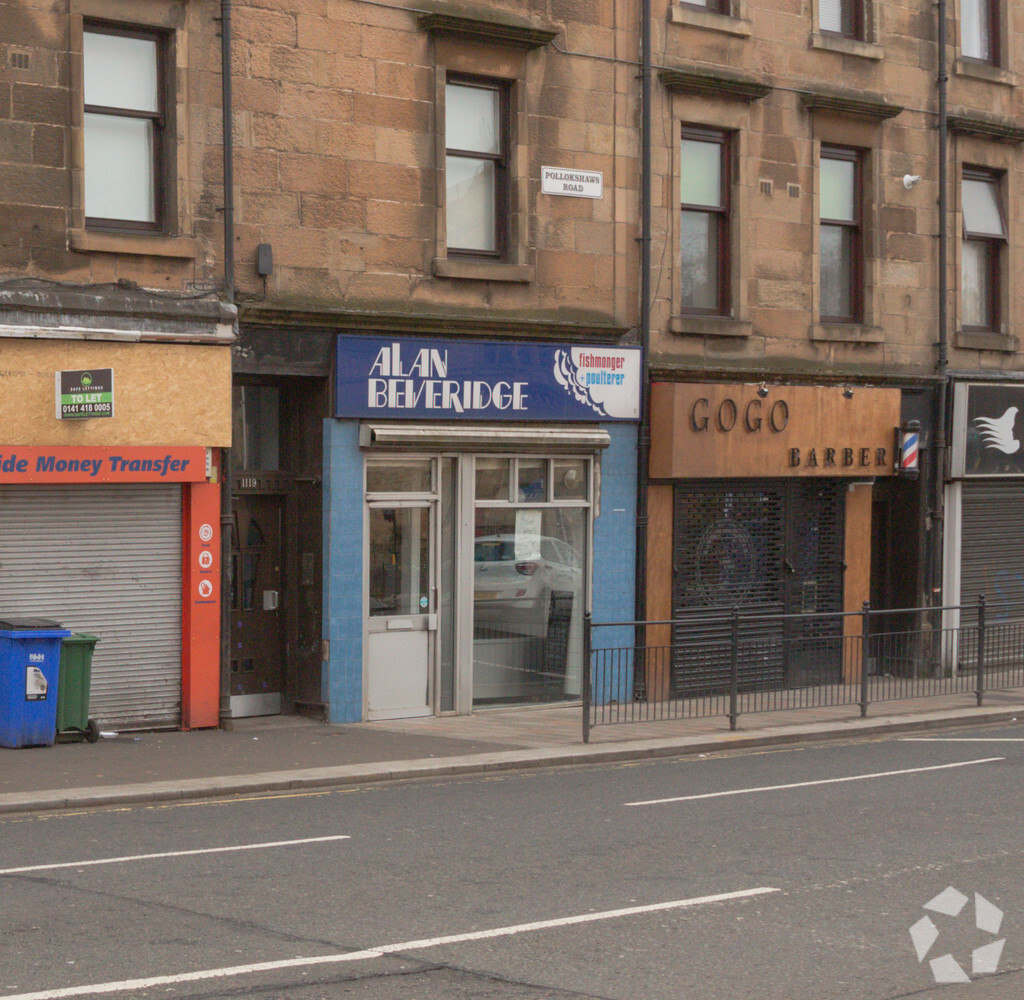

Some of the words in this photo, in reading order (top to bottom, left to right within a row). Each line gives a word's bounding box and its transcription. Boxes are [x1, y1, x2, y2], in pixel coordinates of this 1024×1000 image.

[545, 171, 600, 184] POLLOKSHAWS
[563, 183, 583, 192] ROAD
[368, 343, 448, 378] ALAN
[579, 353, 625, 370] fishmonger
[586, 371, 625, 386] poulterer
[71, 394, 84, 403] TO
[85, 393, 102, 403] LET
[368, 378, 528, 412] BEVERIDGE
[63, 404, 79, 413] 0141
[80, 403, 93, 412] 418
[94, 403, 111, 412] 0005
[691, 398, 789, 433] GOGO
[789, 447, 887, 467] BARBER
[35, 456, 102, 476] Money
[108, 456, 190, 476] Transfer
[242, 478, 257, 488] 1119
